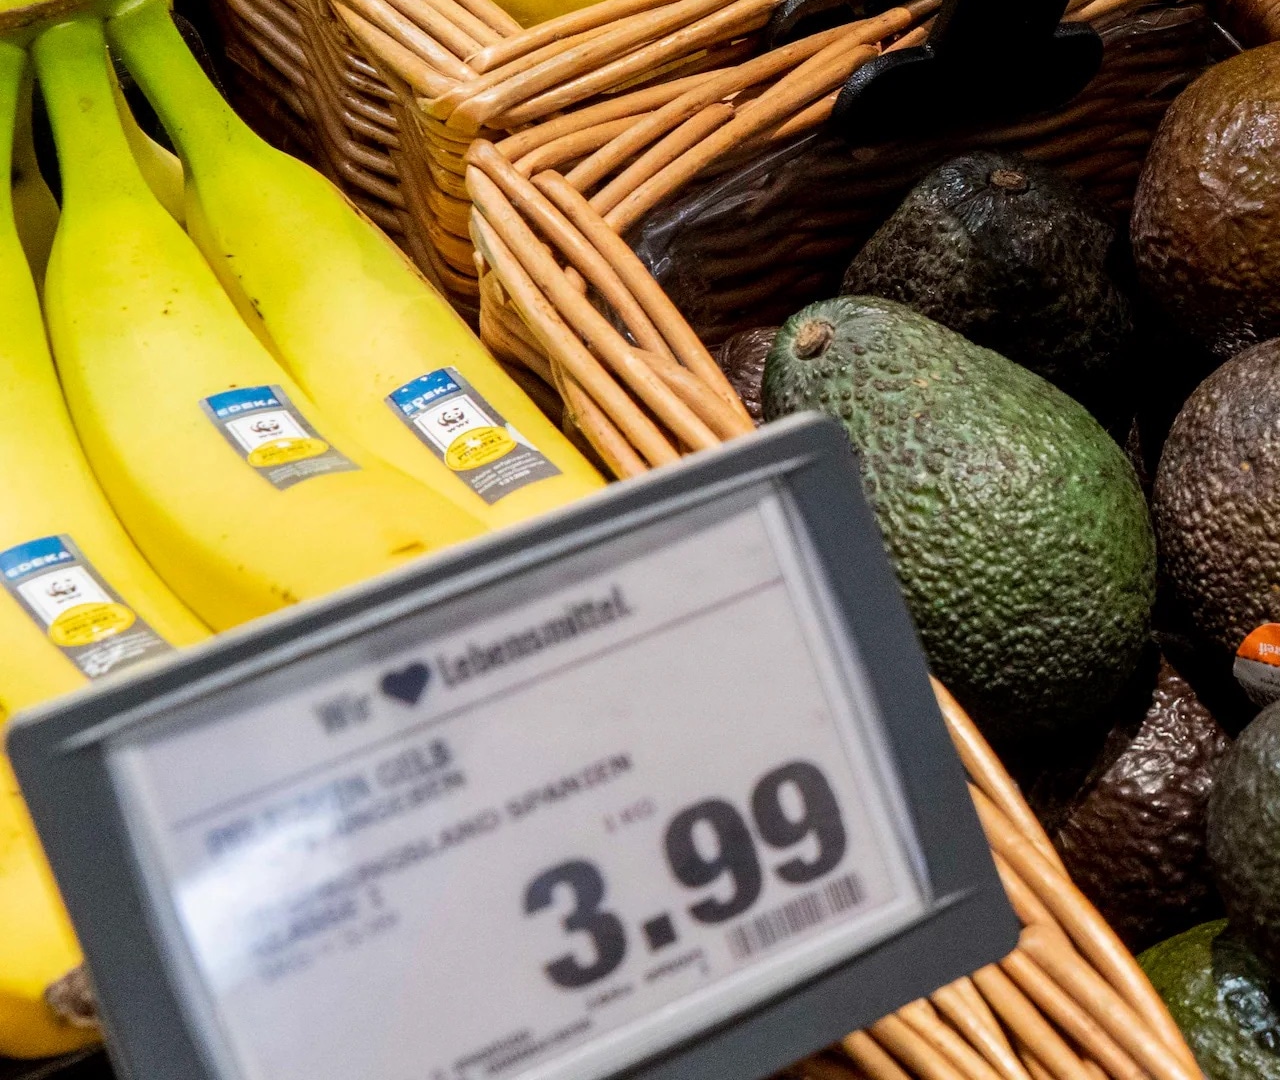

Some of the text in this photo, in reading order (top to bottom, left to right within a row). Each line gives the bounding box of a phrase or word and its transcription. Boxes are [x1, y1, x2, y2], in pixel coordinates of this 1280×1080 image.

[216, 398, 279, 418] EDEKA
[4, 550, 72, 579] EDEKA
[521, 756, 852, 992] 3.99
